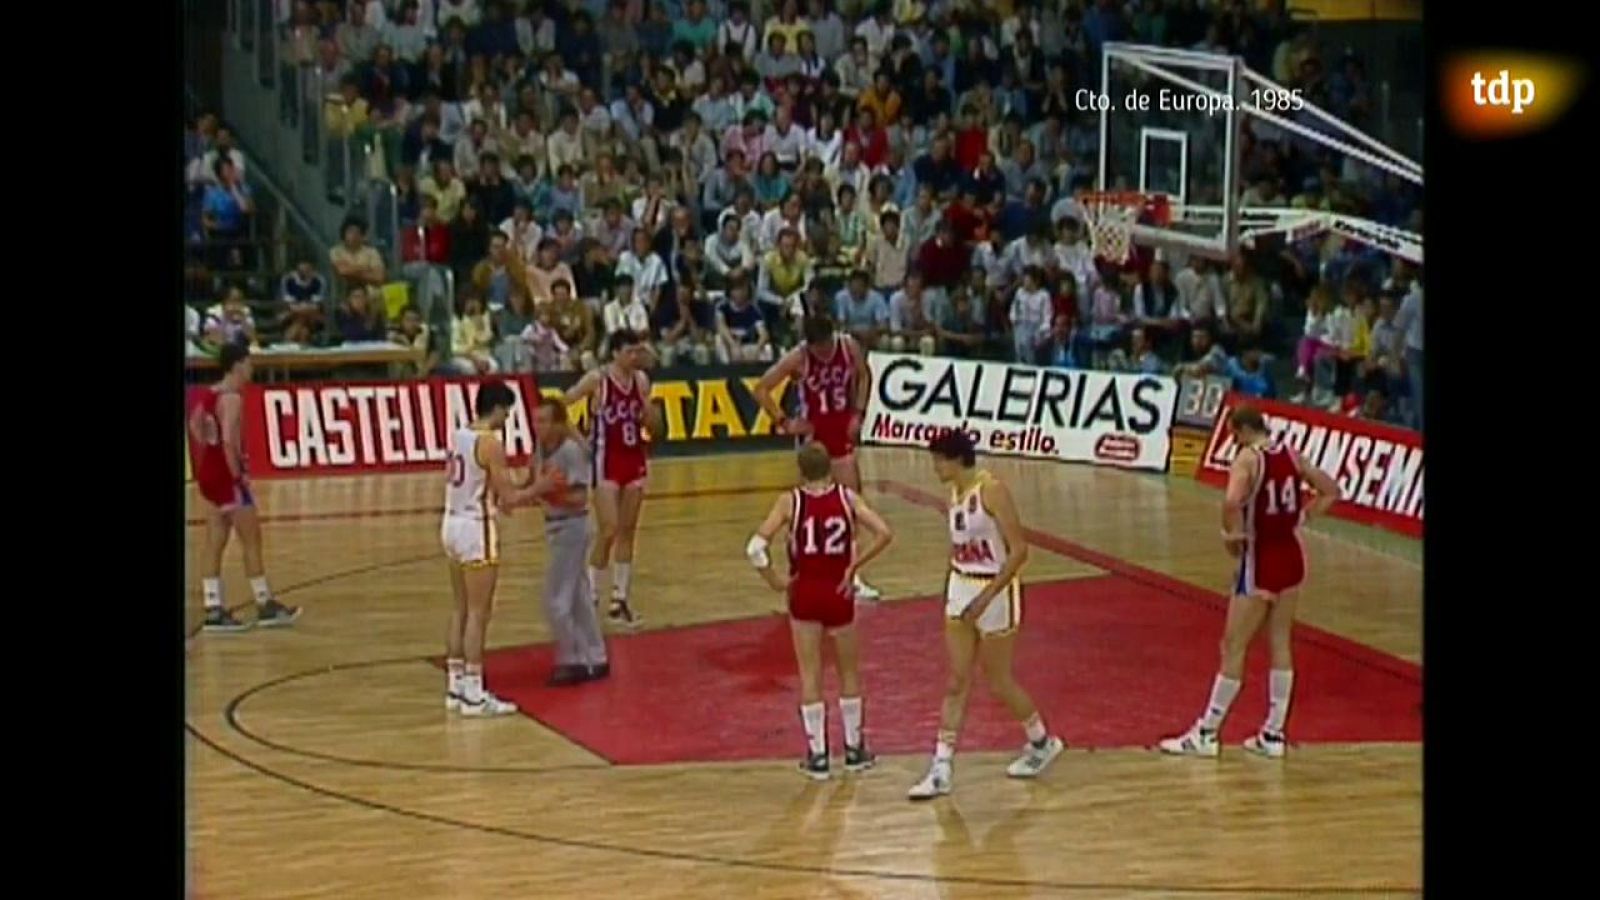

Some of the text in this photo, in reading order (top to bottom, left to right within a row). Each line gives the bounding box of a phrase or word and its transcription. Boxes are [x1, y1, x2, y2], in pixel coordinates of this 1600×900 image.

[819, 387, 846, 414] 15
[878, 358, 1163, 433] GALERIAS
[990, 427, 1060, 455] estilo.
[1264, 475, 1297, 515] 14
[803, 516, 847, 555] 12
